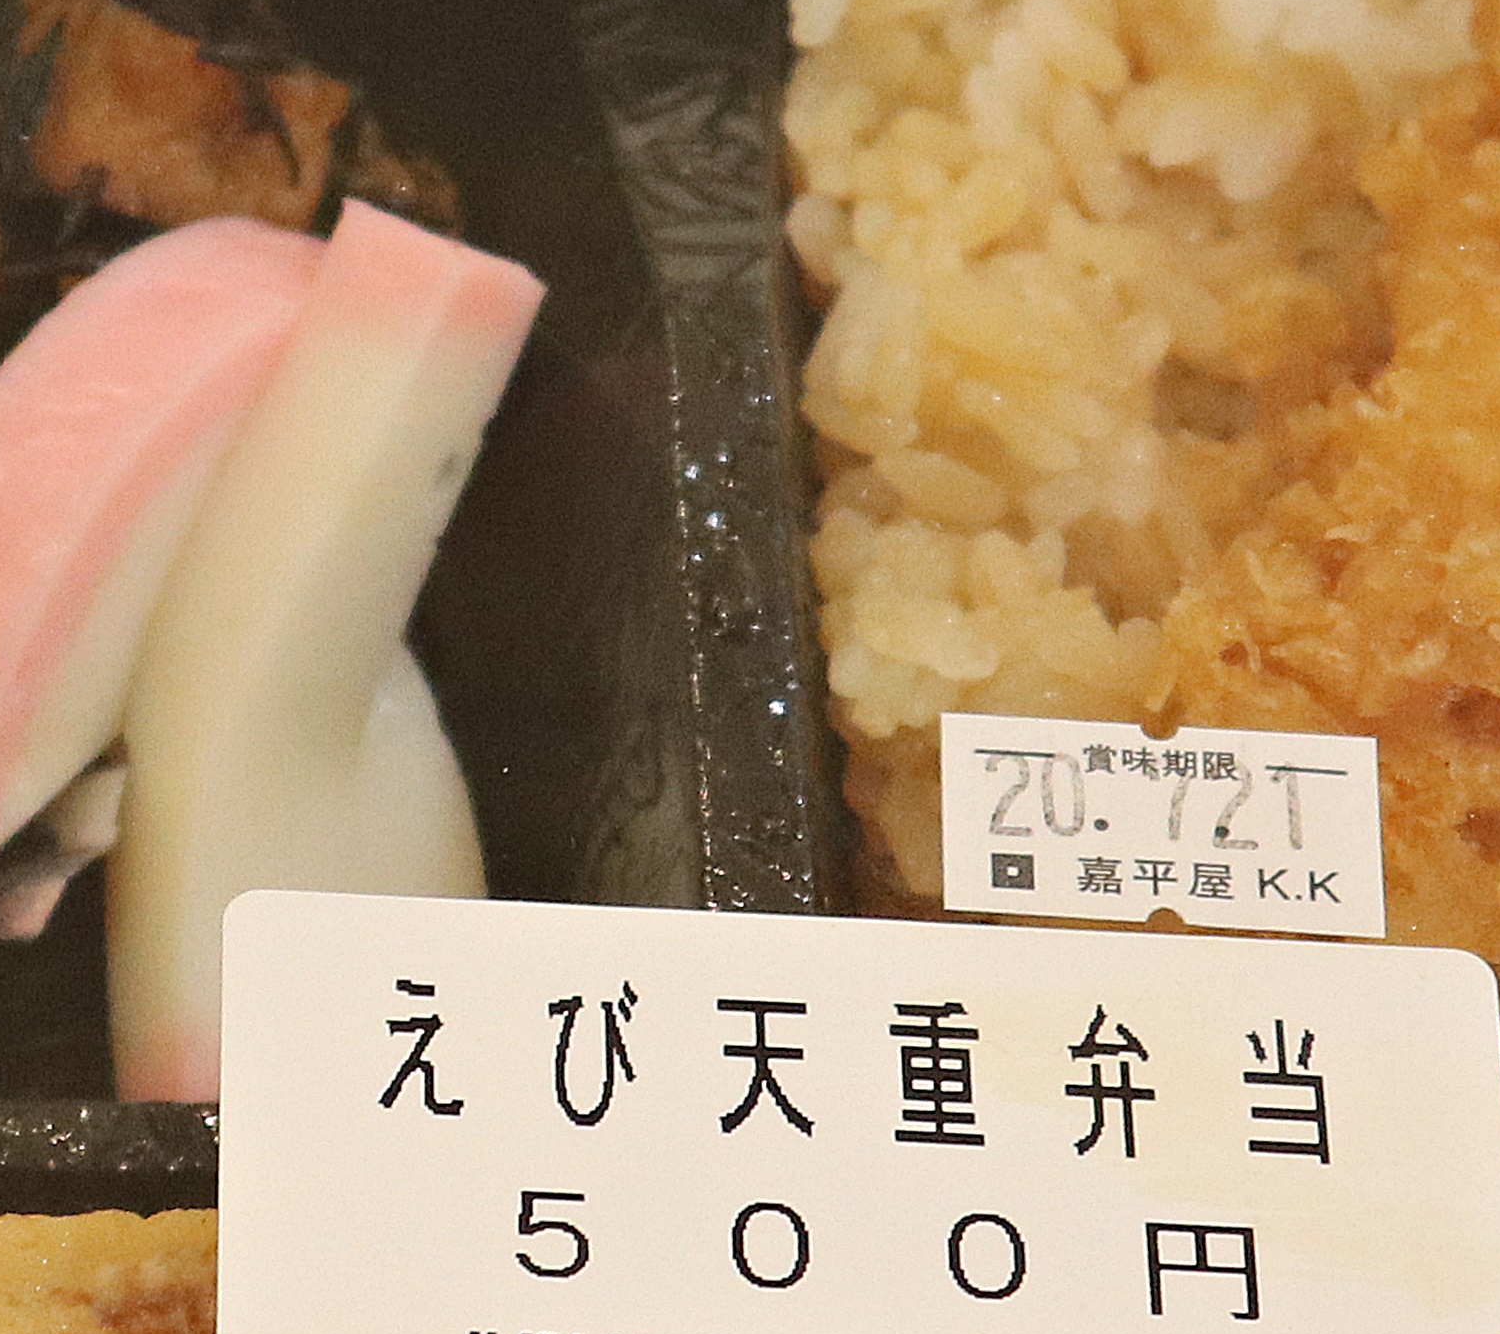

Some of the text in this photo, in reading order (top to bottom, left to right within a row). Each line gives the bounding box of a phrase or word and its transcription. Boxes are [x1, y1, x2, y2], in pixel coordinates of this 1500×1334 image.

[1082, 744, 1239, 781] 賞味期限
[1077, 856, 1235, 900] 嘉平屋
[377, 979, 1333, 1165] えび天重弁当
[514, 1190, 1262, 1322] 500円
